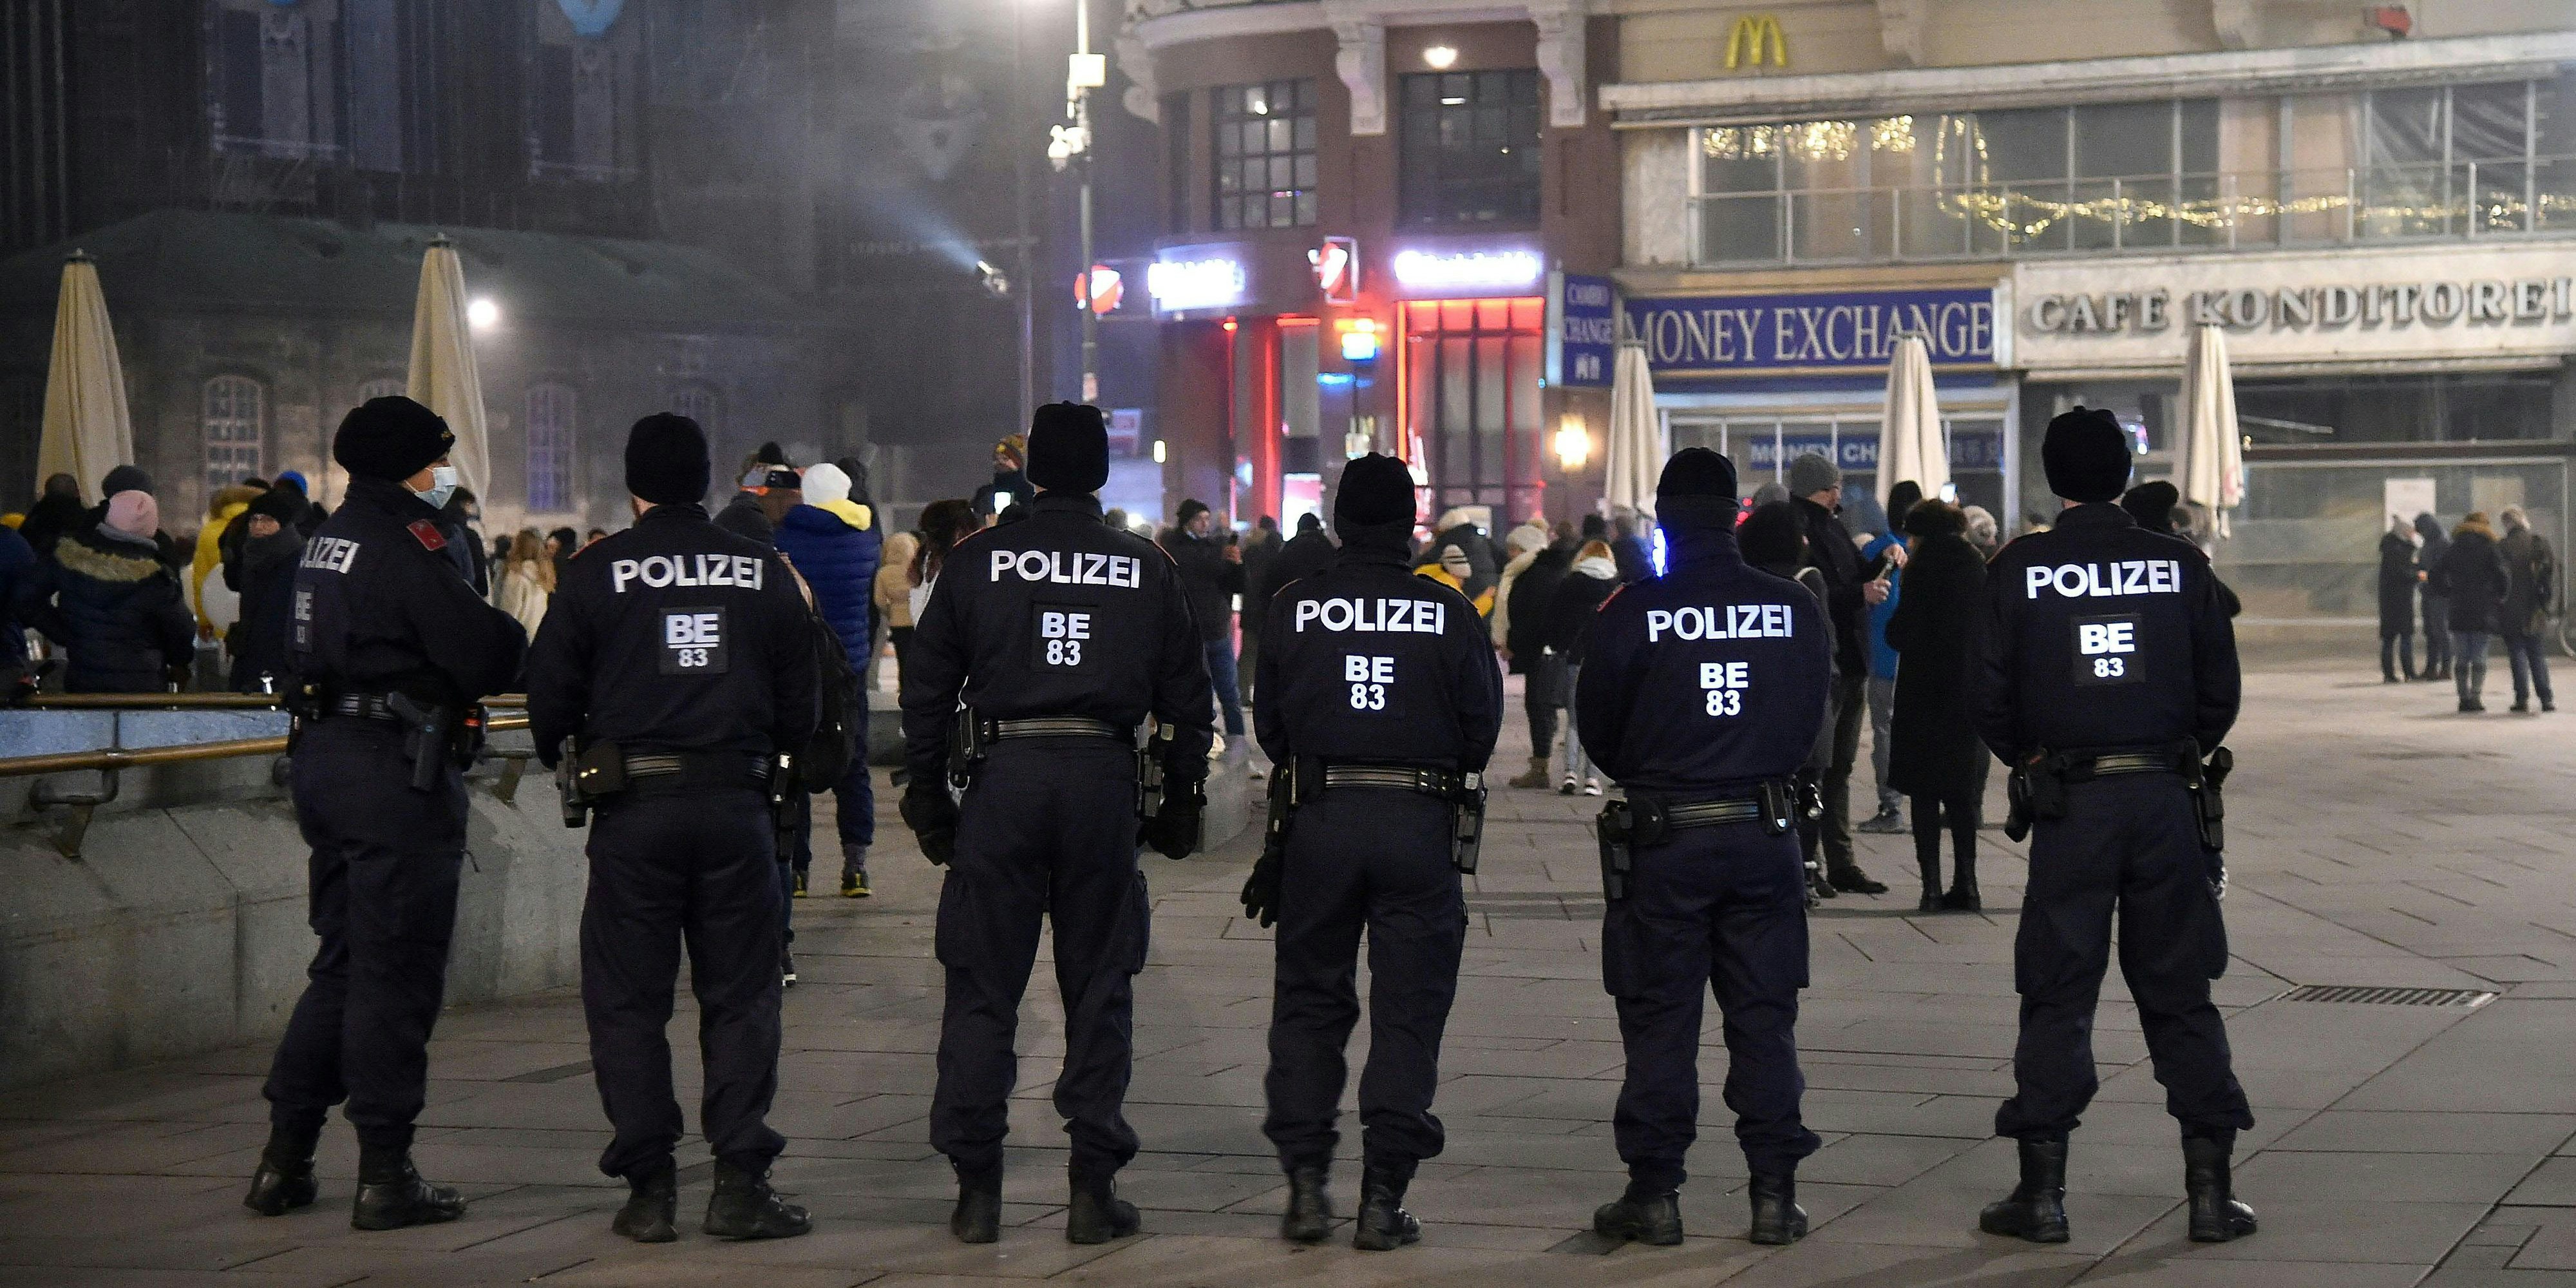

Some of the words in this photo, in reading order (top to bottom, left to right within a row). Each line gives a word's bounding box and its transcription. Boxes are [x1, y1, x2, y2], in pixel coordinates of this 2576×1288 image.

[2190, 277, 2571, 330] KONDITOREI
[1624, 307, 1763, 363] MONEY
[1774, 301, 1994, 360] EXCHANGE
[299, 536, 361, 574] LIZEI
[991, 550, 1141, 589] POLIZEI
[612, 554, 762, 592] POLIZEI
[2027, 560, 2181, 599] POLIZEI
[666, 613, 720, 643] BE
[1042, 612, 1090, 639] BE
[1296, 598, 1444, 635] POLIZEI
[1647, 604, 1792, 642] POLIZEI
[1046, 639, 1081, 666] 83
[2079, 622, 2136, 655] BE
[678, 649, 708, 667] 83
[1345, 655, 1394, 683] BE
[2094, 657, 2125, 678] 83
[1700, 661, 1748, 689] BE
[1350, 683, 1385, 710] 83
[1706, 689, 1741, 716] 83
